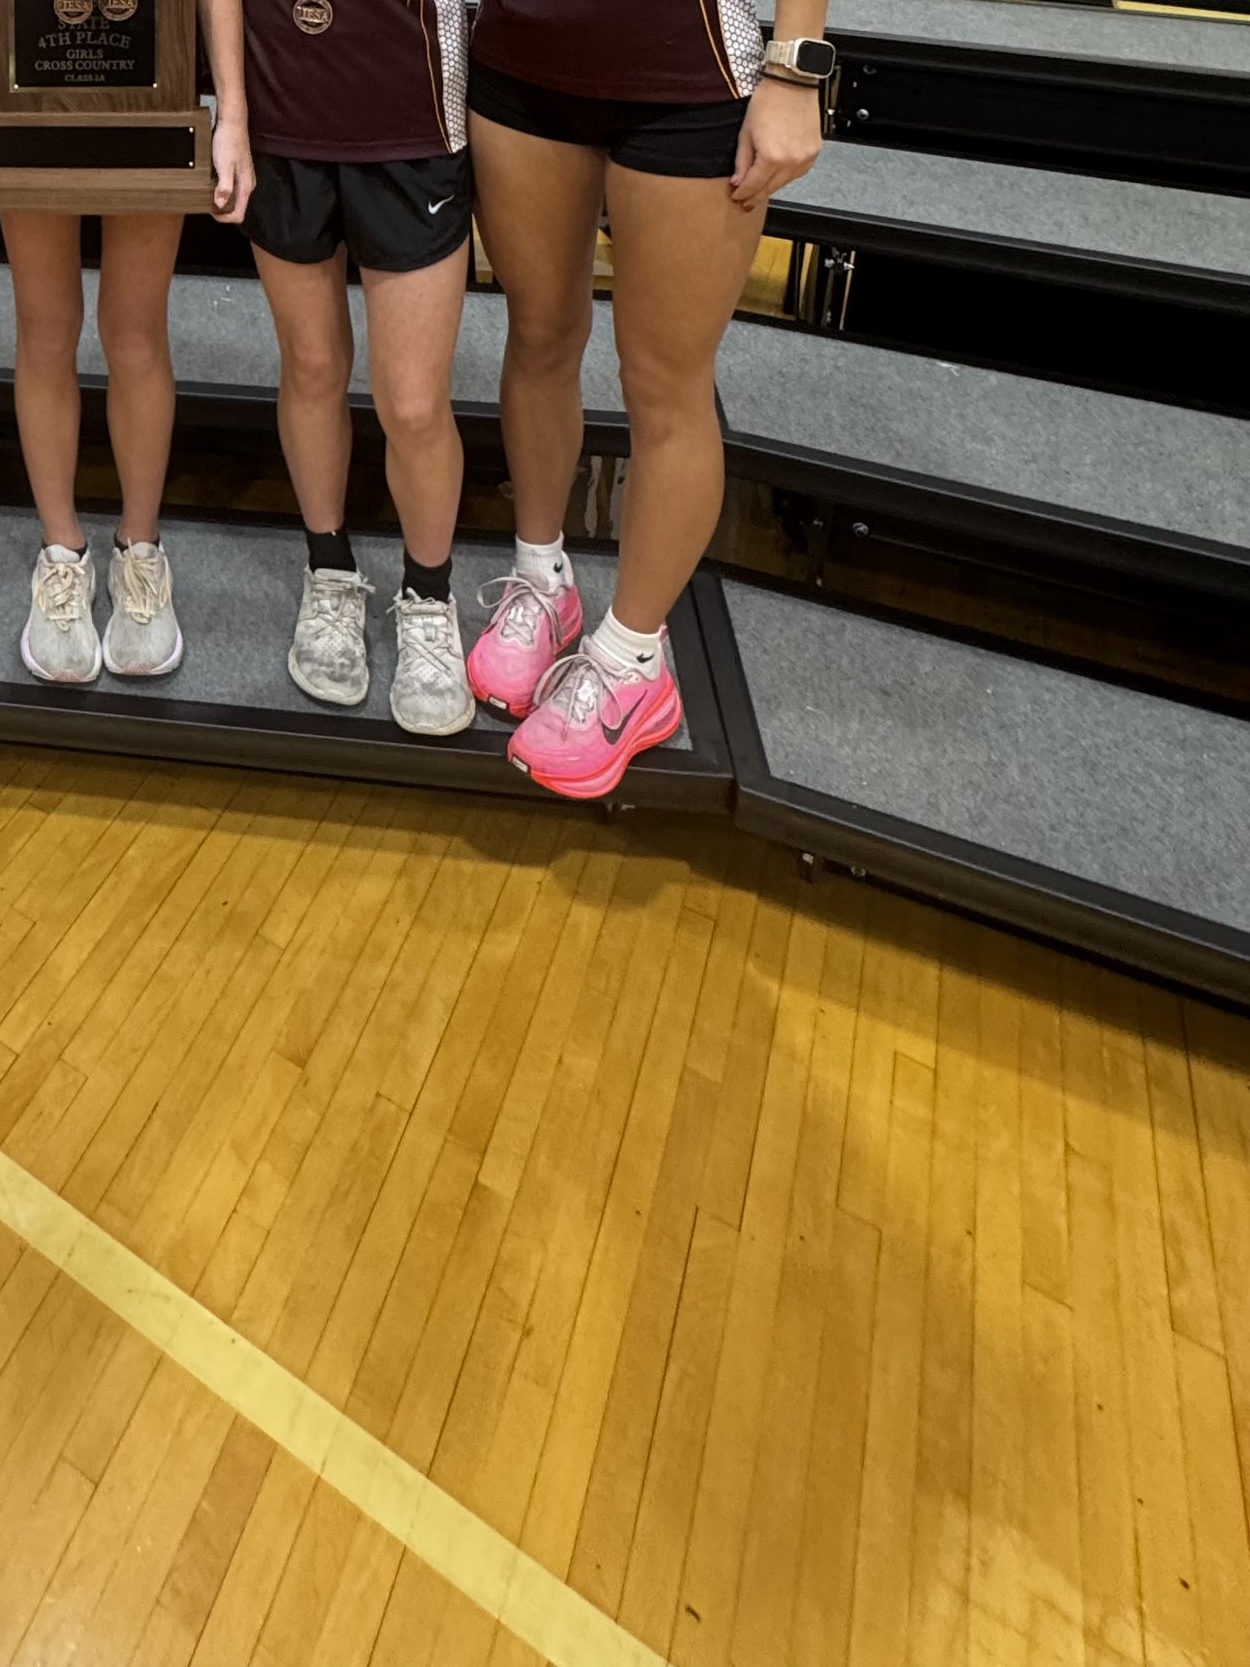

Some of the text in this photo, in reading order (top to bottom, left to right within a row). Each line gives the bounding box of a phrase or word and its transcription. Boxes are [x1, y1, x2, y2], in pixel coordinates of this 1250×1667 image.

[62, 0, 90, 11] IESA
[37, 31, 132, 49] 4TH PLACE
[66, 48, 104, 60] GIRLS
[34, 60, 135, 71] CROSS COUNTRY
[63, 74, 93, 82] CLASS
